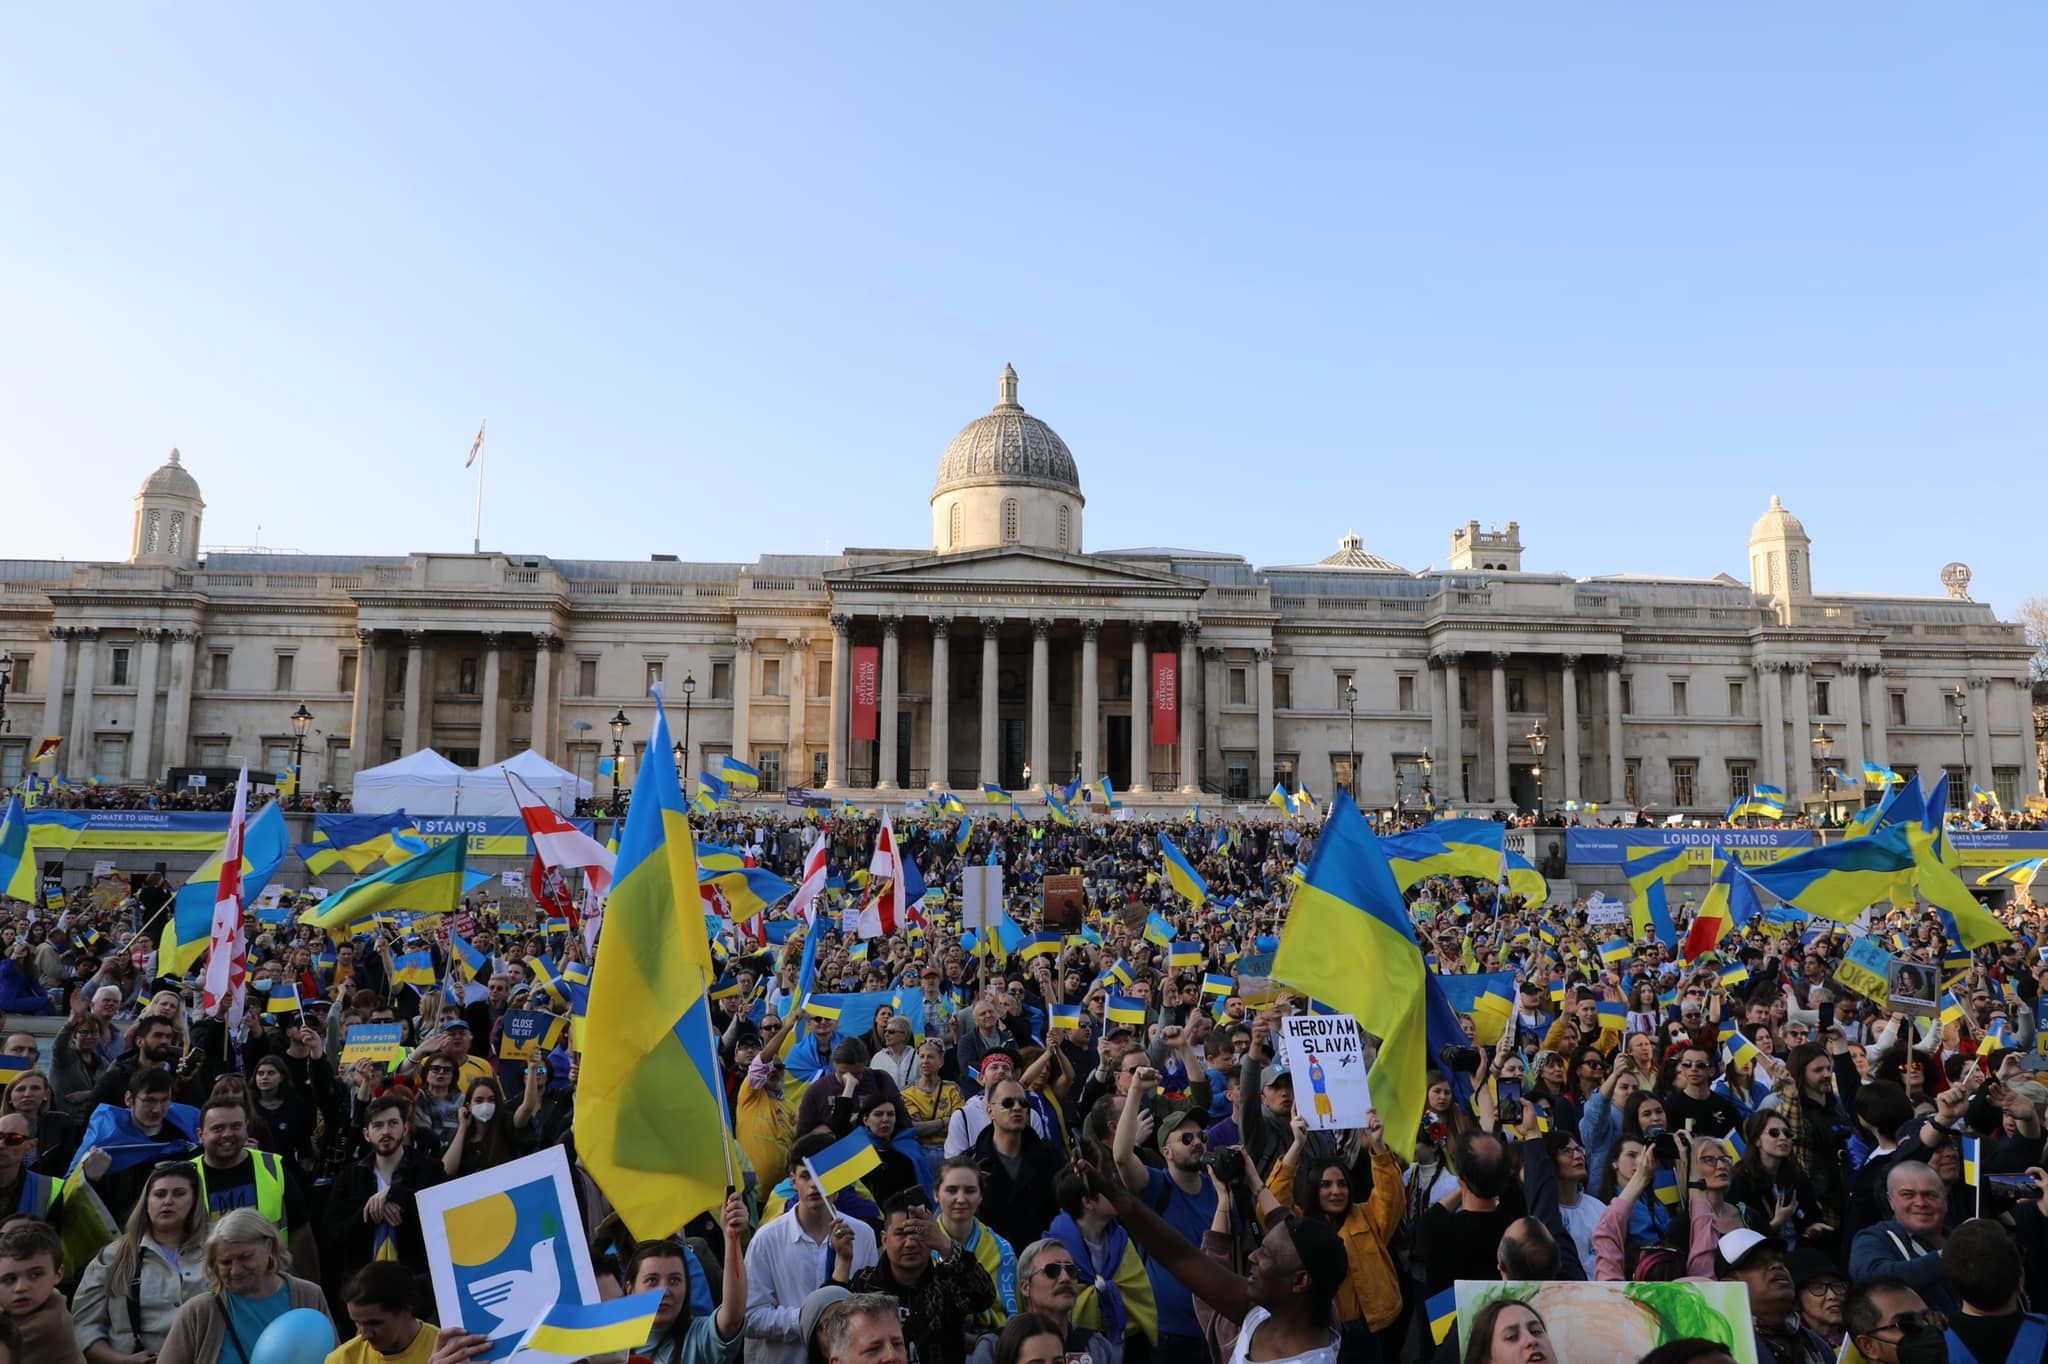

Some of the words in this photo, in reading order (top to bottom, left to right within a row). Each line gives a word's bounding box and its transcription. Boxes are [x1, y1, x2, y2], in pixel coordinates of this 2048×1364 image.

[859, 661, 867, 705] NATIONAL
[866, 662, 875, 705] GALLERY
[1159, 667, 1167, 710] NATIONAL
[1166, 667, 1175, 710] GALLERY
[425, 820, 487, 833] STANDS
[1663, 833, 1721, 845] LONDON
[1724, 833, 1778, 846] STANDS
[1686, 849, 1705, 860] TH
[512, 1018, 534, 1029] CLOSE
[1288, 1018, 1356, 1037] HEROYAM
[511, 1028, 521, 1036] THE
[521, 1029, 533, 1037] SKY
[1302, 1037, 1357, 1054] SLAVA!
